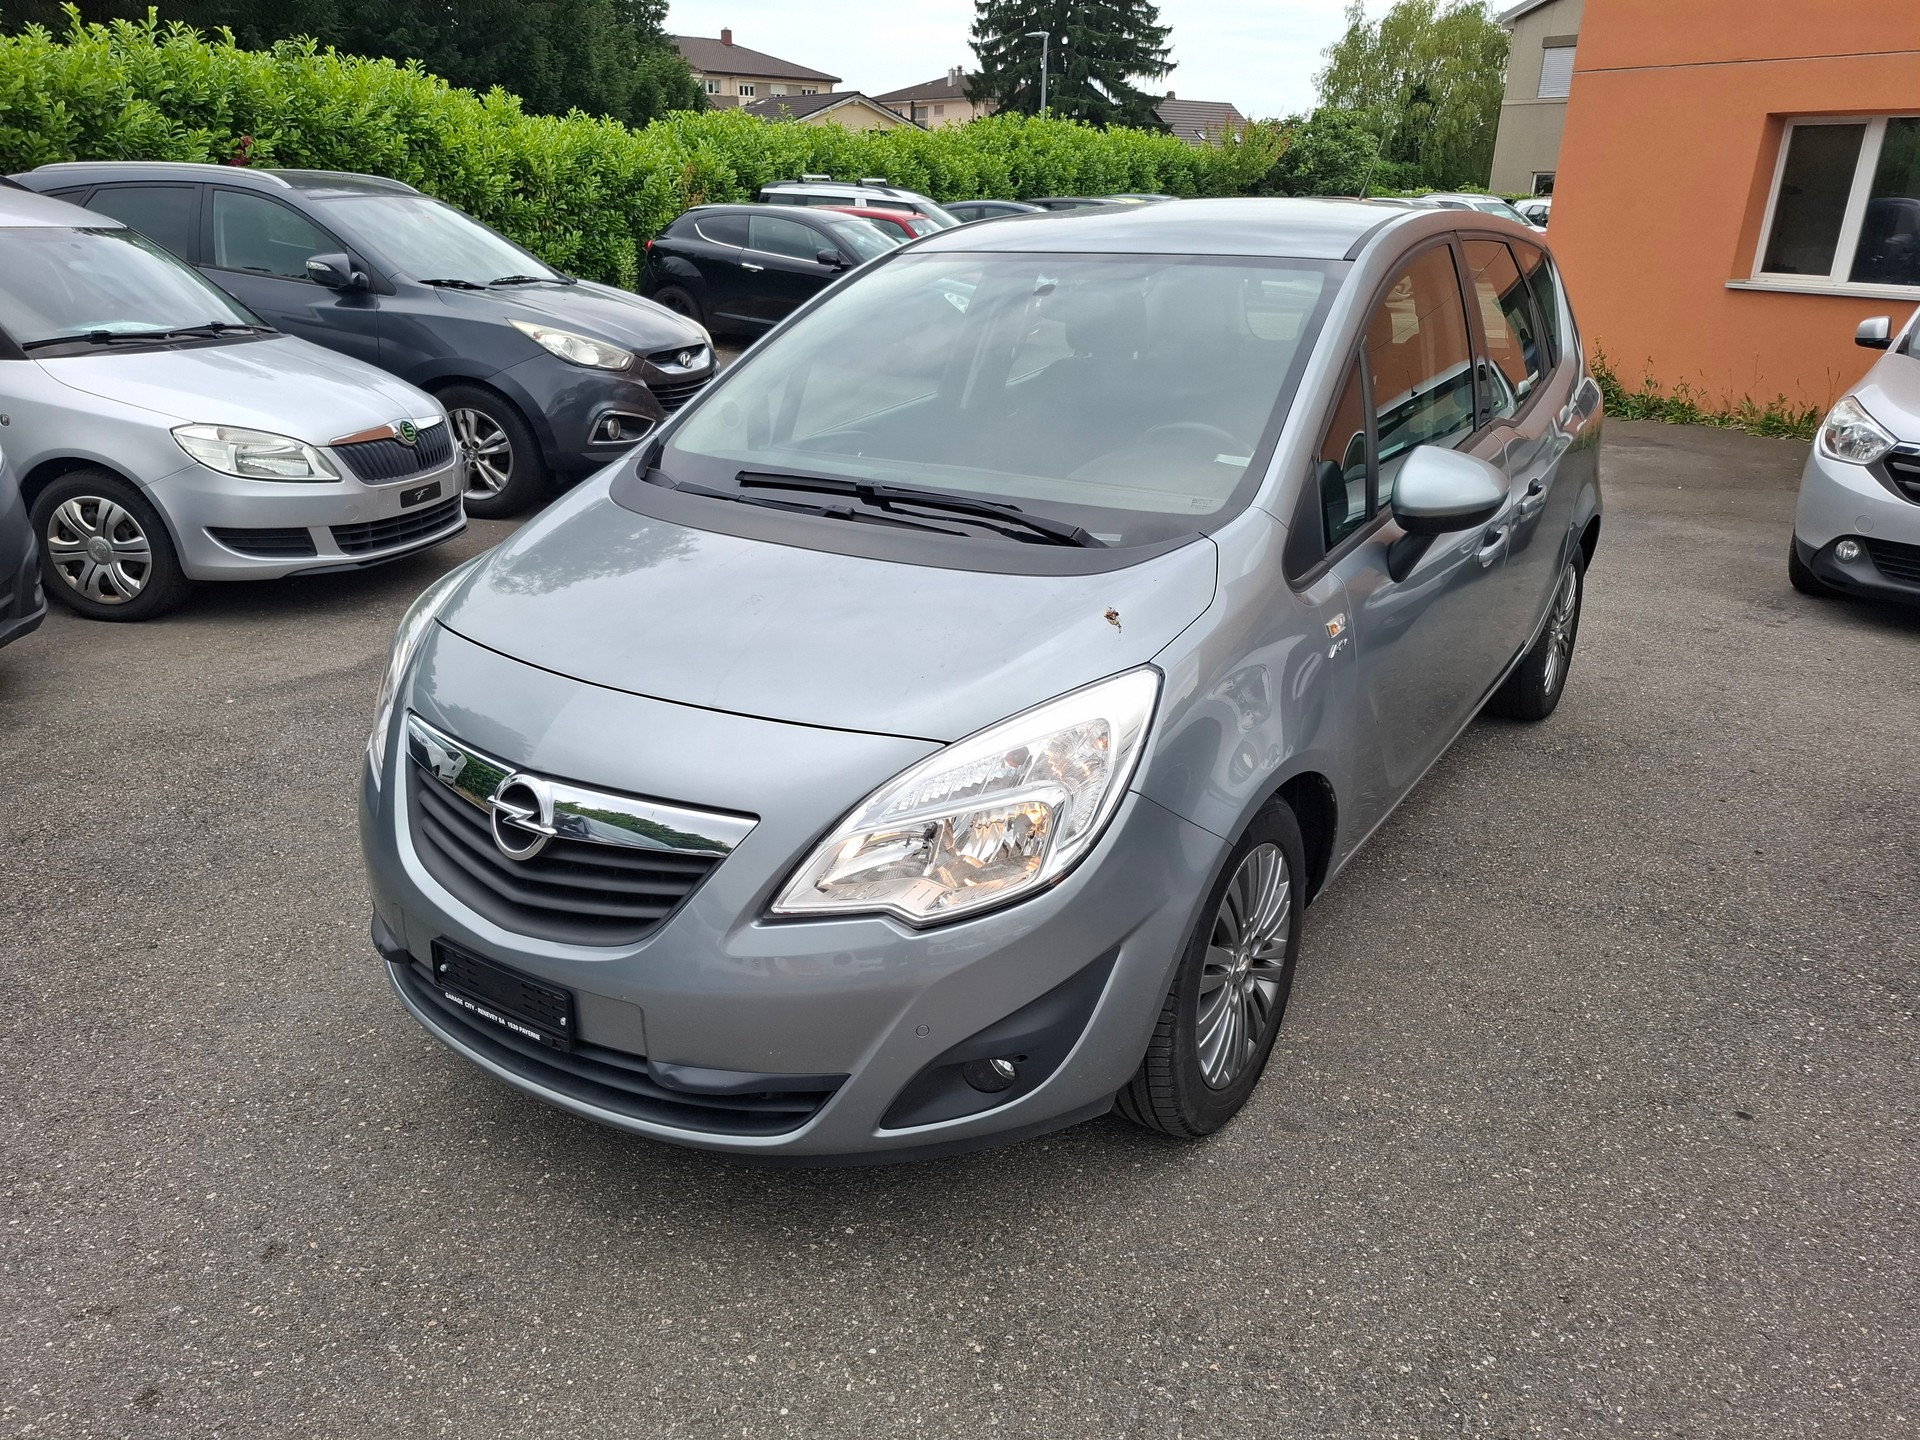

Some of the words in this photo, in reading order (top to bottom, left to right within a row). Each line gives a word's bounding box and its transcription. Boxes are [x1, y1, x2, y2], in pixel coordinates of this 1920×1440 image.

[445, 992, 463, 1005] GARAGE
[464, 1001, 474, 1010] CITY
[478, 1007, 497, 1021] RENEVEY
[498, 1017, 505, 1025] SA
[507, 1021, 518, 1031] 1530
[519, 1026, 540, 1040] PAYERNE
